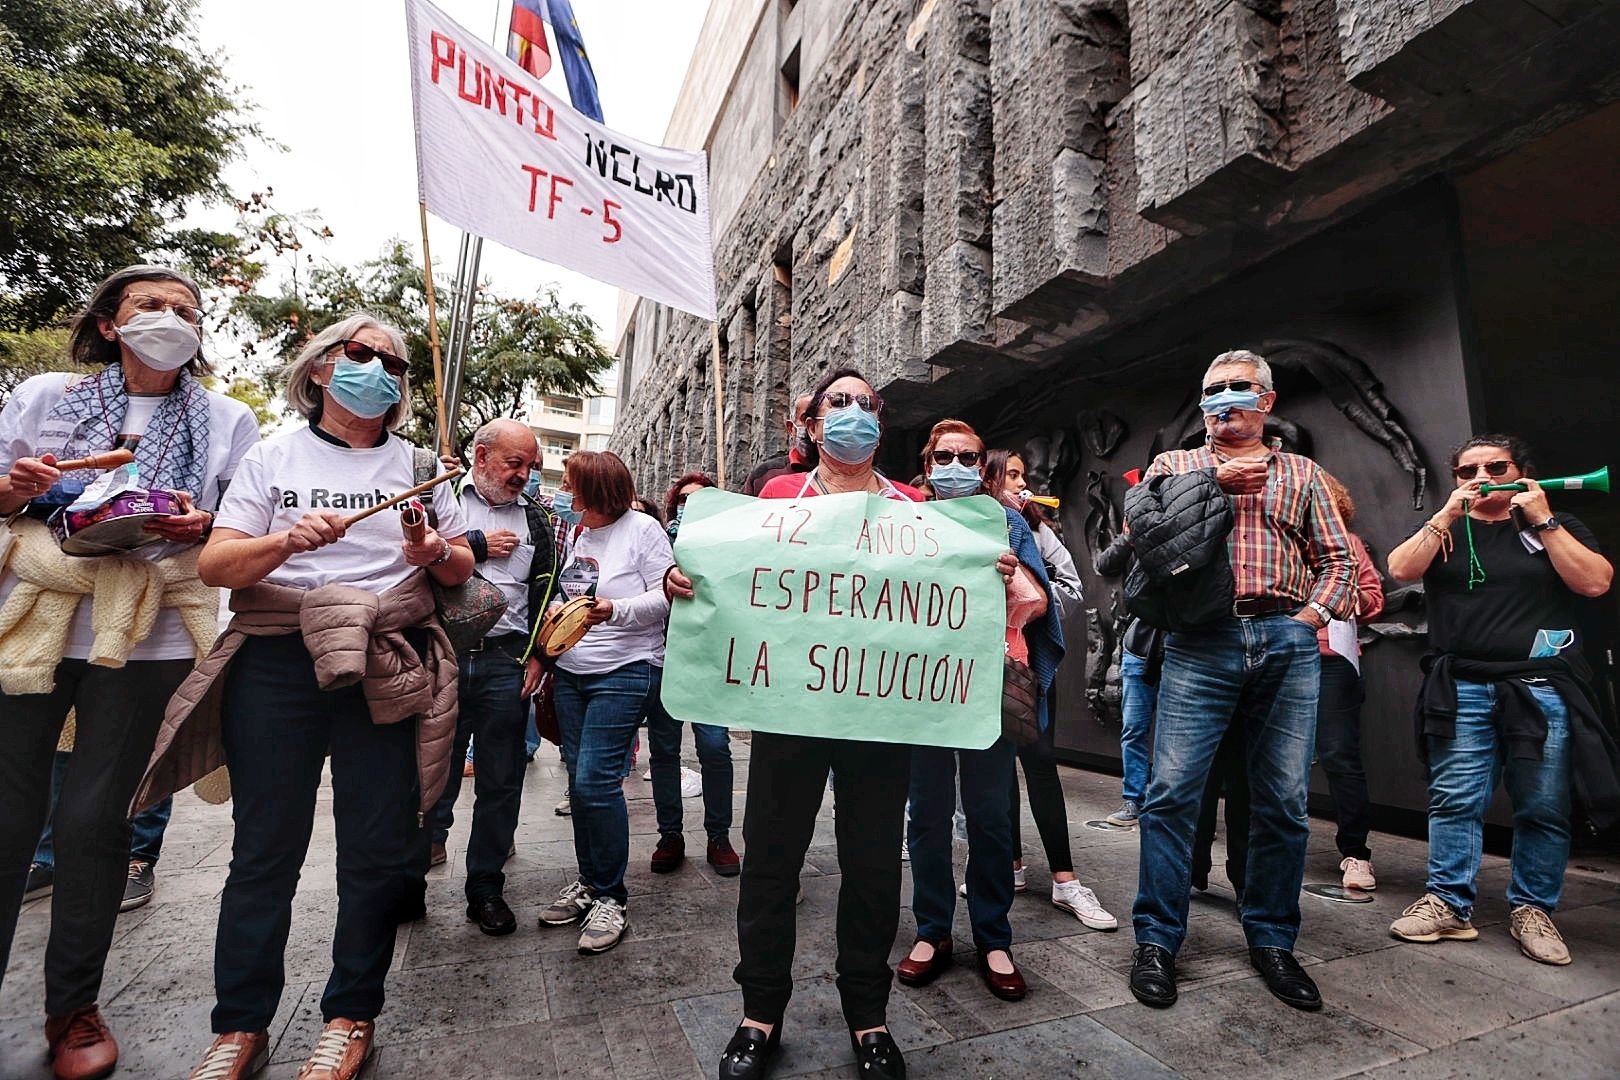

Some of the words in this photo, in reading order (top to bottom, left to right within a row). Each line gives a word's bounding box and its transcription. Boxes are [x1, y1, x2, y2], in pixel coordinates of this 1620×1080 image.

[431, 30, 557, 141] PUNTO
[761, 509, 812, 545] 42
[856, 516, 939, 558] AÑOS
[750, 568, 967, 630] ESPERANDO
[725, 637, 770, 688] LA
[806, 644, 974, 705] SOLUCIÓN
